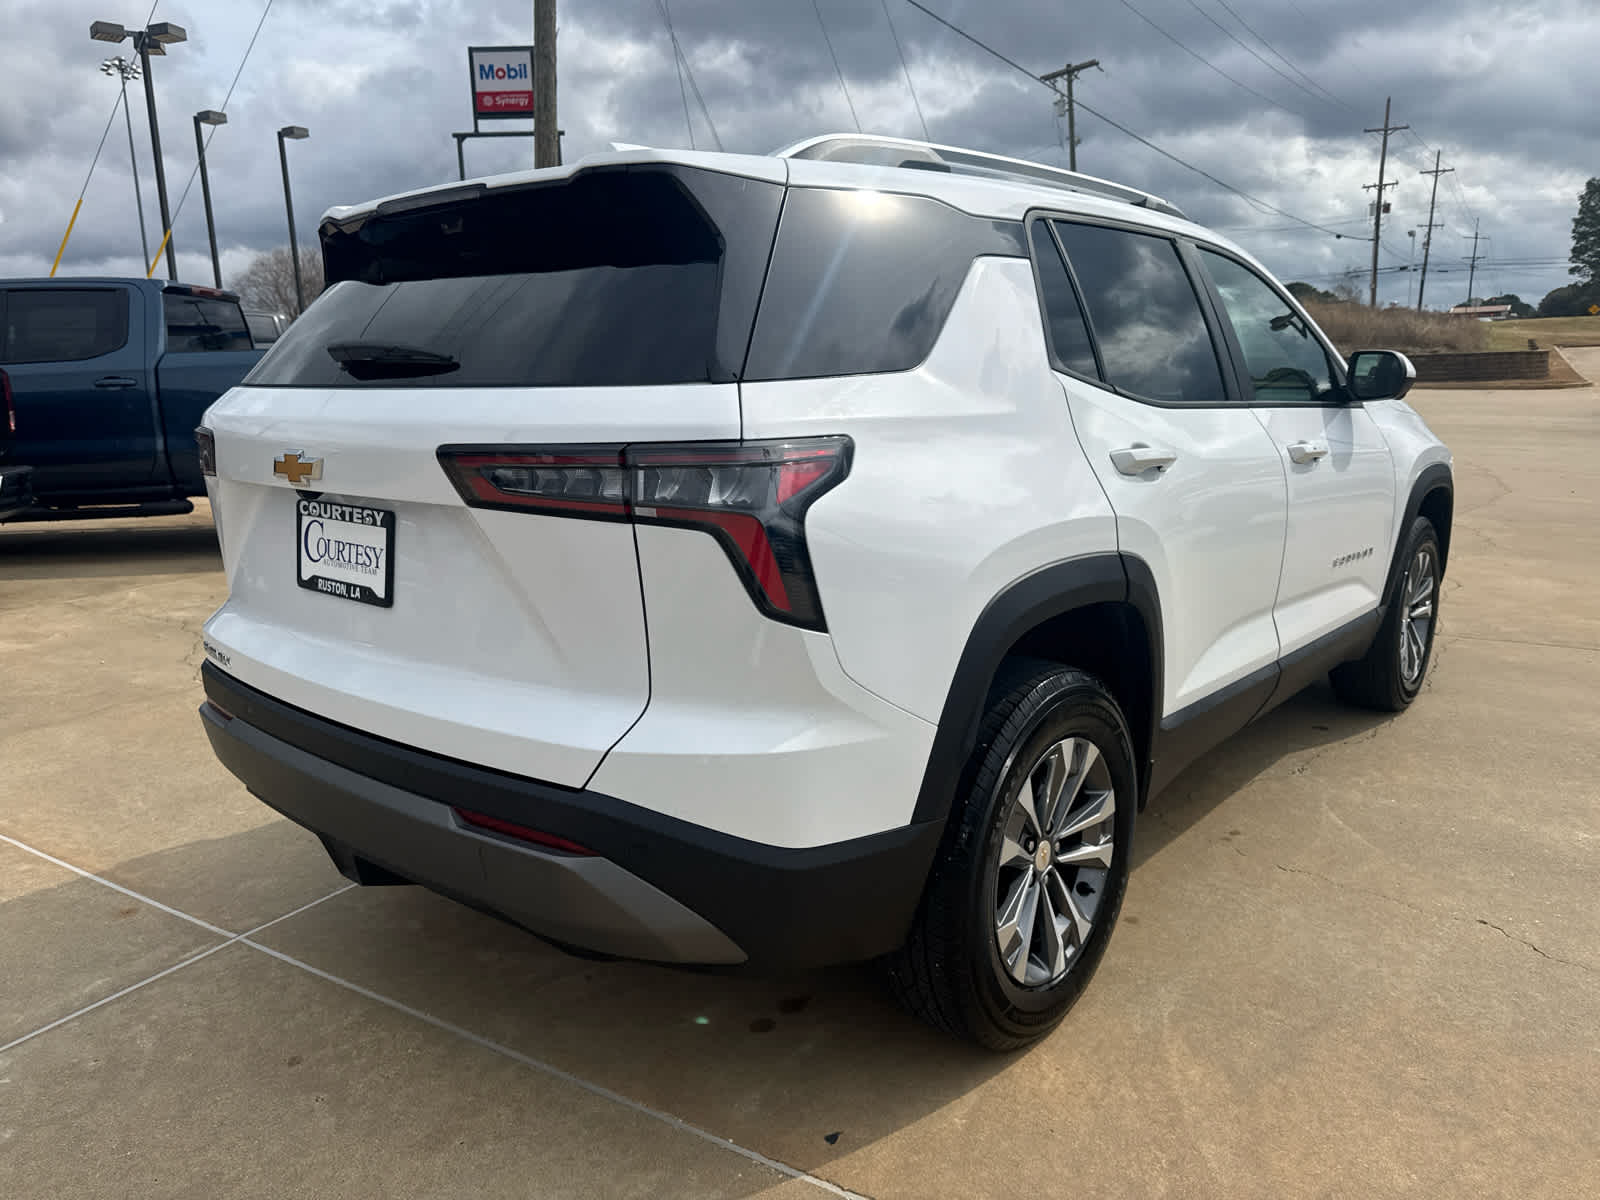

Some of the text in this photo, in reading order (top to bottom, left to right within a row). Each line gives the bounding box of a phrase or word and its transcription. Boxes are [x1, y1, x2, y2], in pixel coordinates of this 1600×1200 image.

[479, 64, 528, 80] Mobil
[495, 96, 529, 106] Synergy
[299, 501, 384, 526] COURTESY
[361, 565, 377, 575] TEAM
[318, 579, 361, 599] RUSTON, LA
